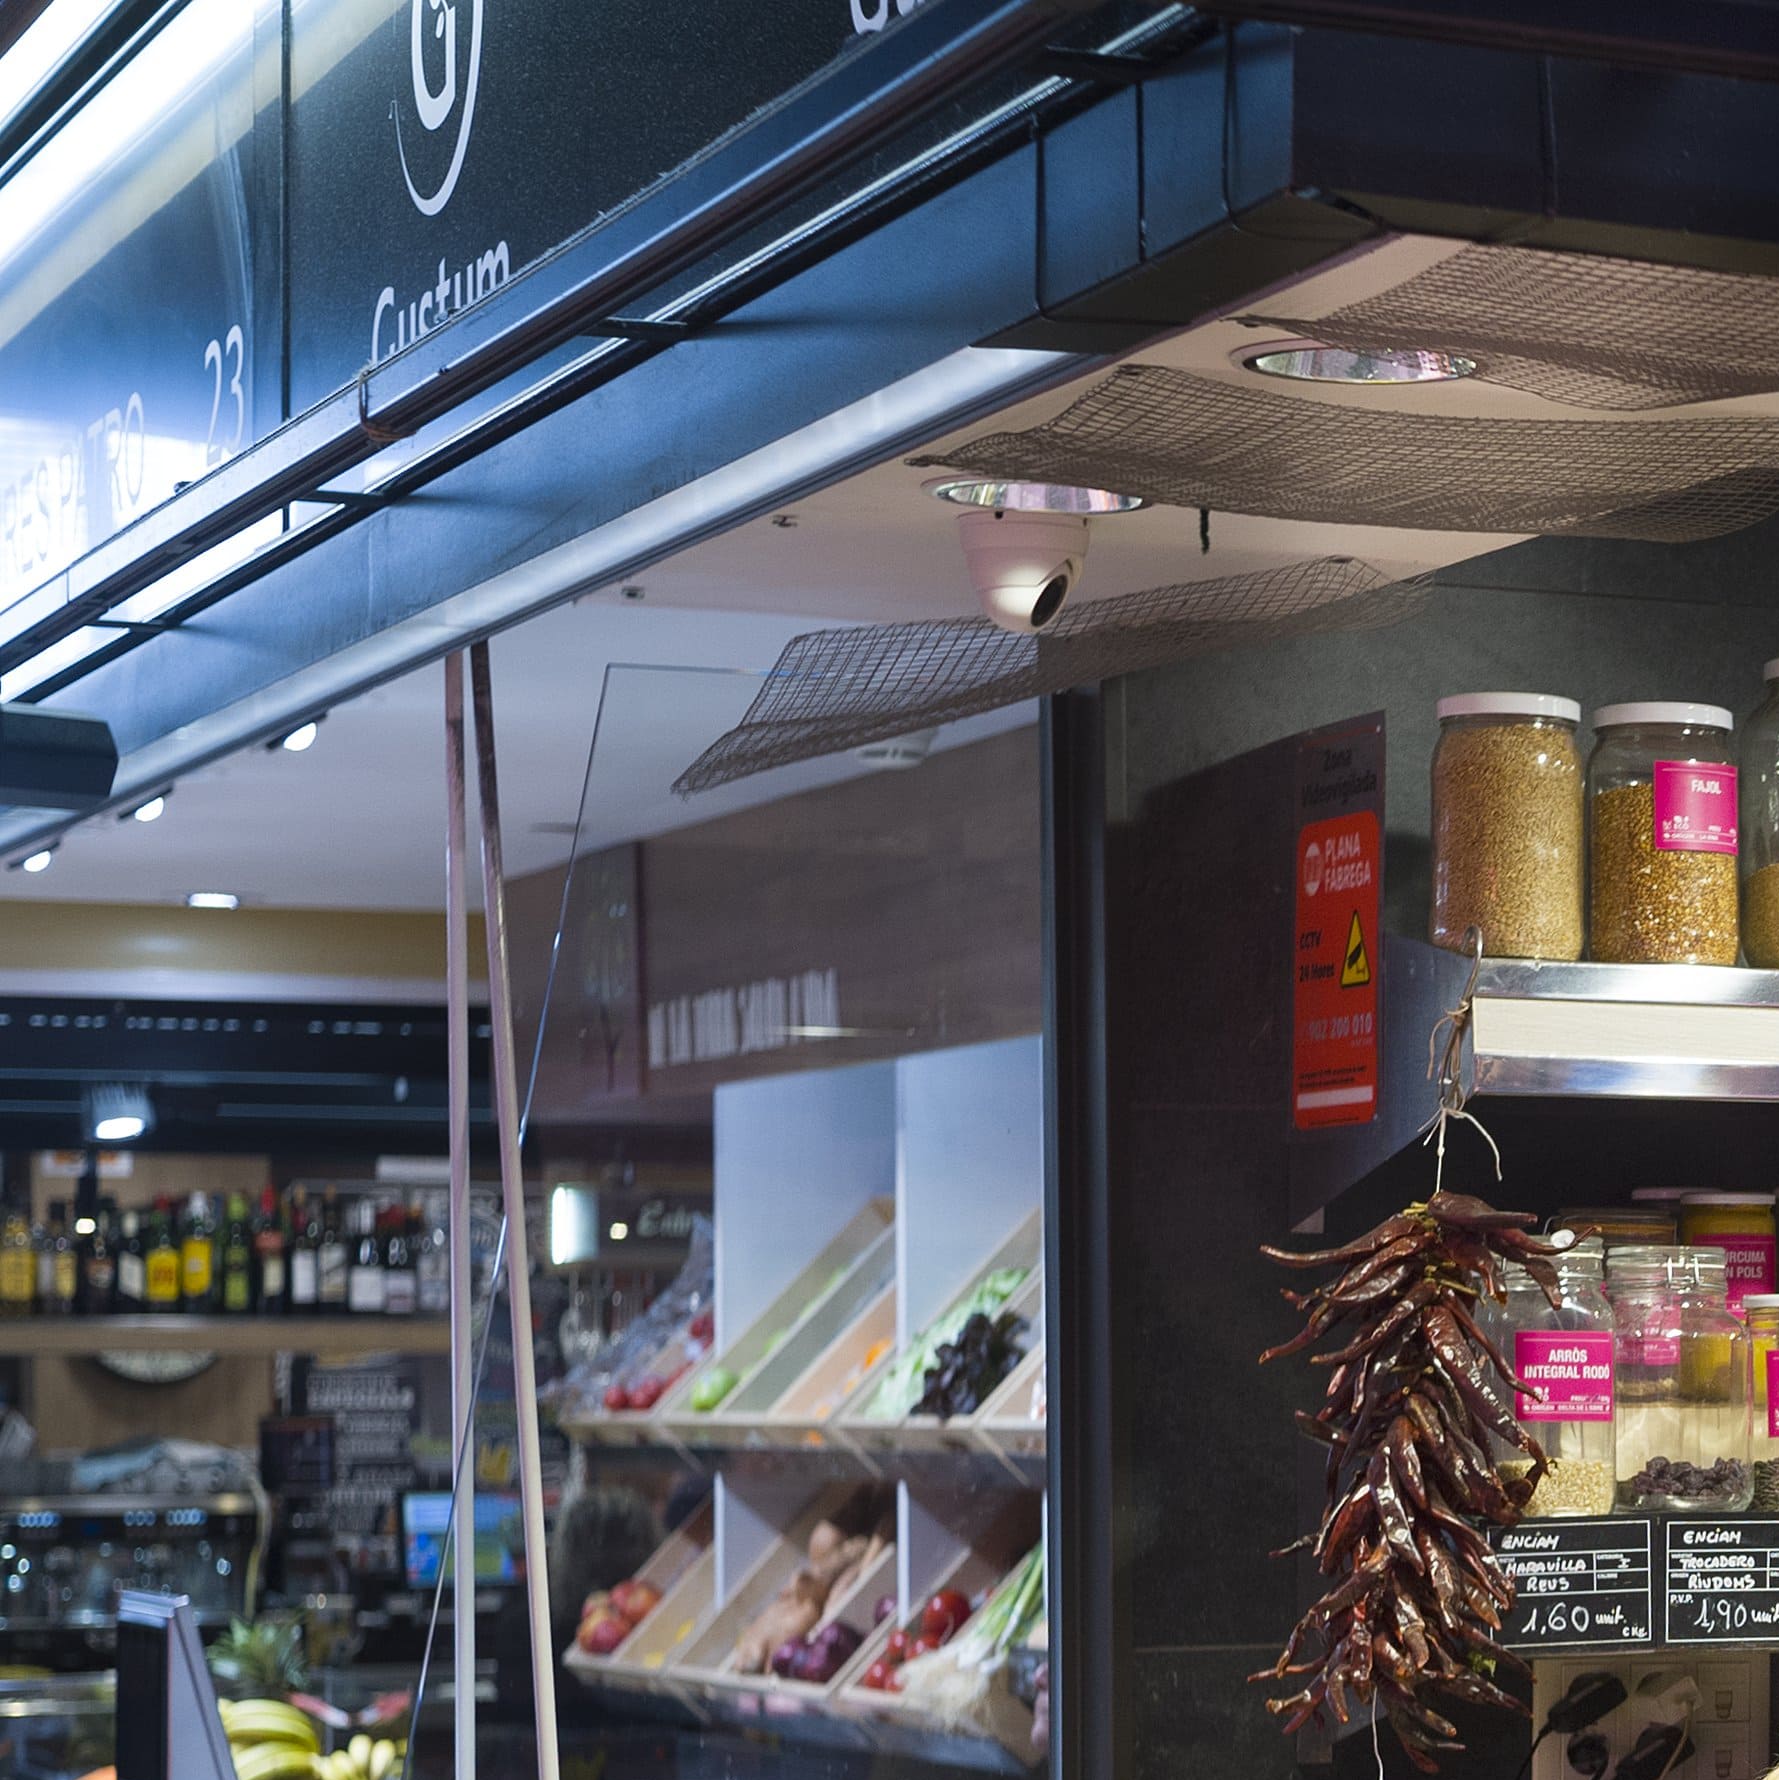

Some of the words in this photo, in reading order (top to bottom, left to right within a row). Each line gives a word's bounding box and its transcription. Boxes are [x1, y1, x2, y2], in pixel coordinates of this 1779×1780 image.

[204, 325, 244, 466] 23
[1691, 779, 1722, 795] FAJOL
[1325, 832, 1361, 864] PLANA
[1300, 929, 1322, 949] CCTV
[1300, 966, 1310, 982] 24
[1309, 1018, 1328, 1041] 902
[1331, 1015, 1350, 1038] 200
[1353, 1011, 1373, 1034] 010
[1736, 1266, 1763, 1279] POLS
[1524, 1364, 1581, 1379] INTEGRAL
[1679, 1555, 1756, 1570] TROCADERO
[1521, 1602, 1590, 1635] 1,60
[1693, 1599, 1747, 1633] 1,90
